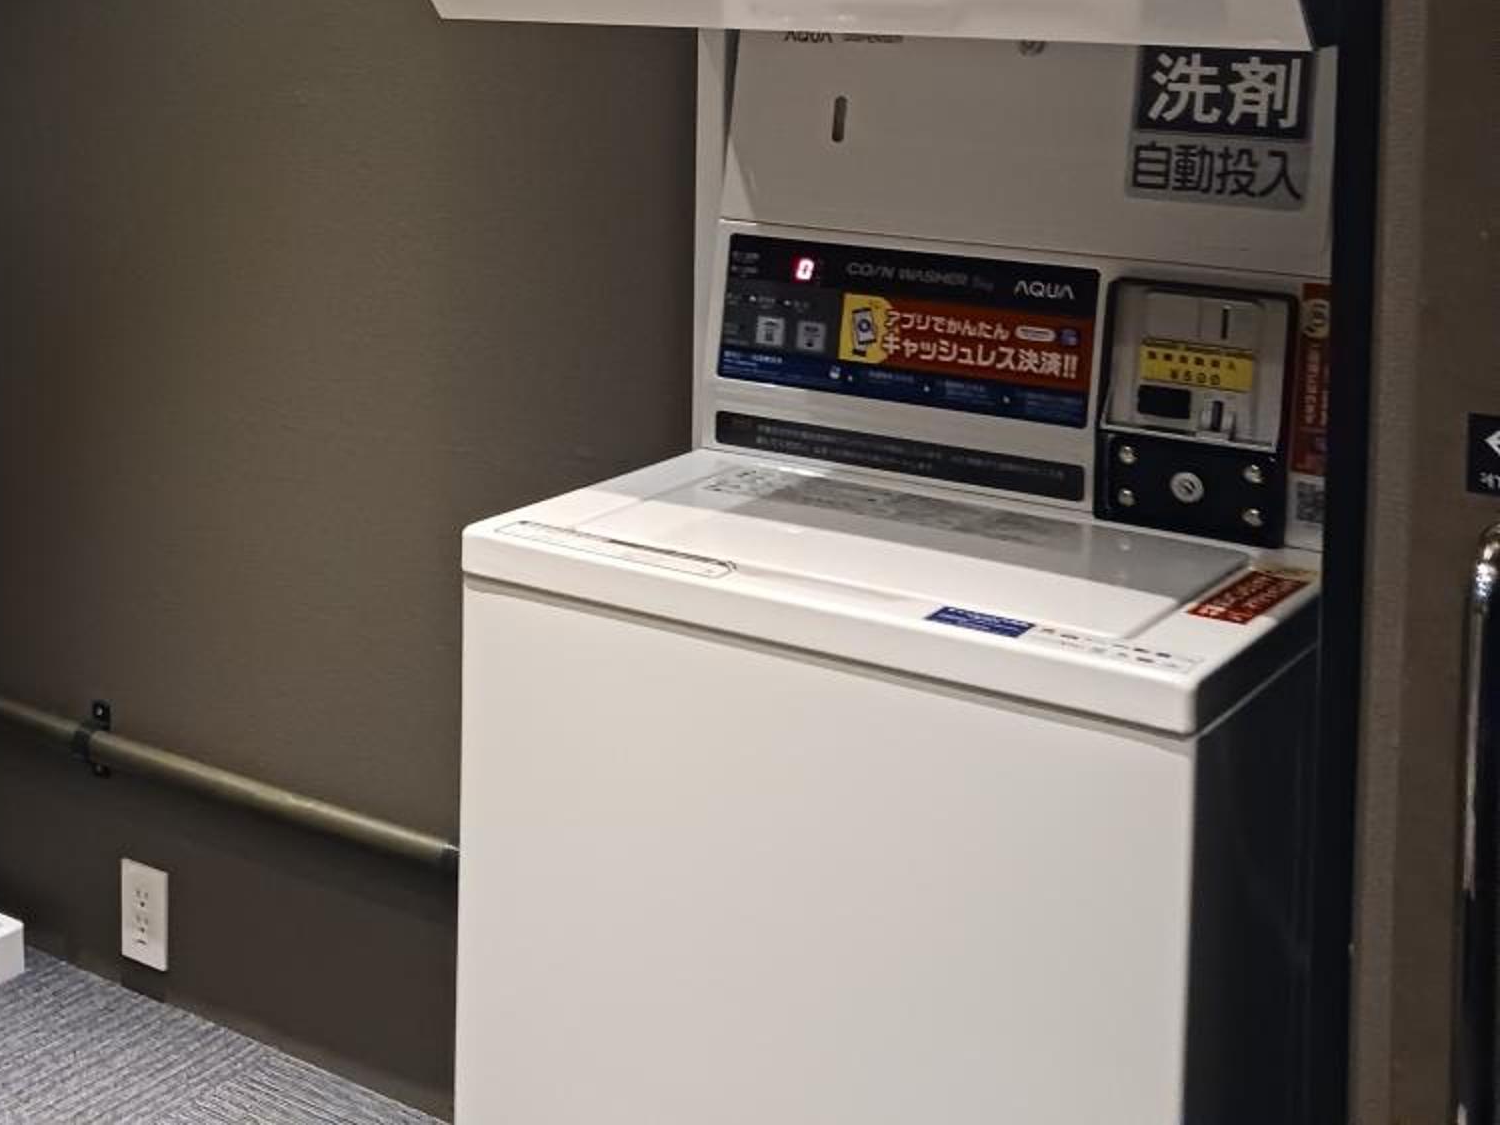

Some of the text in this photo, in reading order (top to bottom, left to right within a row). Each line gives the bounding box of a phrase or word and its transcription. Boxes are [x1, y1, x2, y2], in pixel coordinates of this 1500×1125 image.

[1148, 52, 1301, 130] 洗剤
[1132, 141, 1303, 201] 自動投入
[1014, 279, 1076, 300] AQUA
[884, 310, 1010, 341] アプリでかんたん
